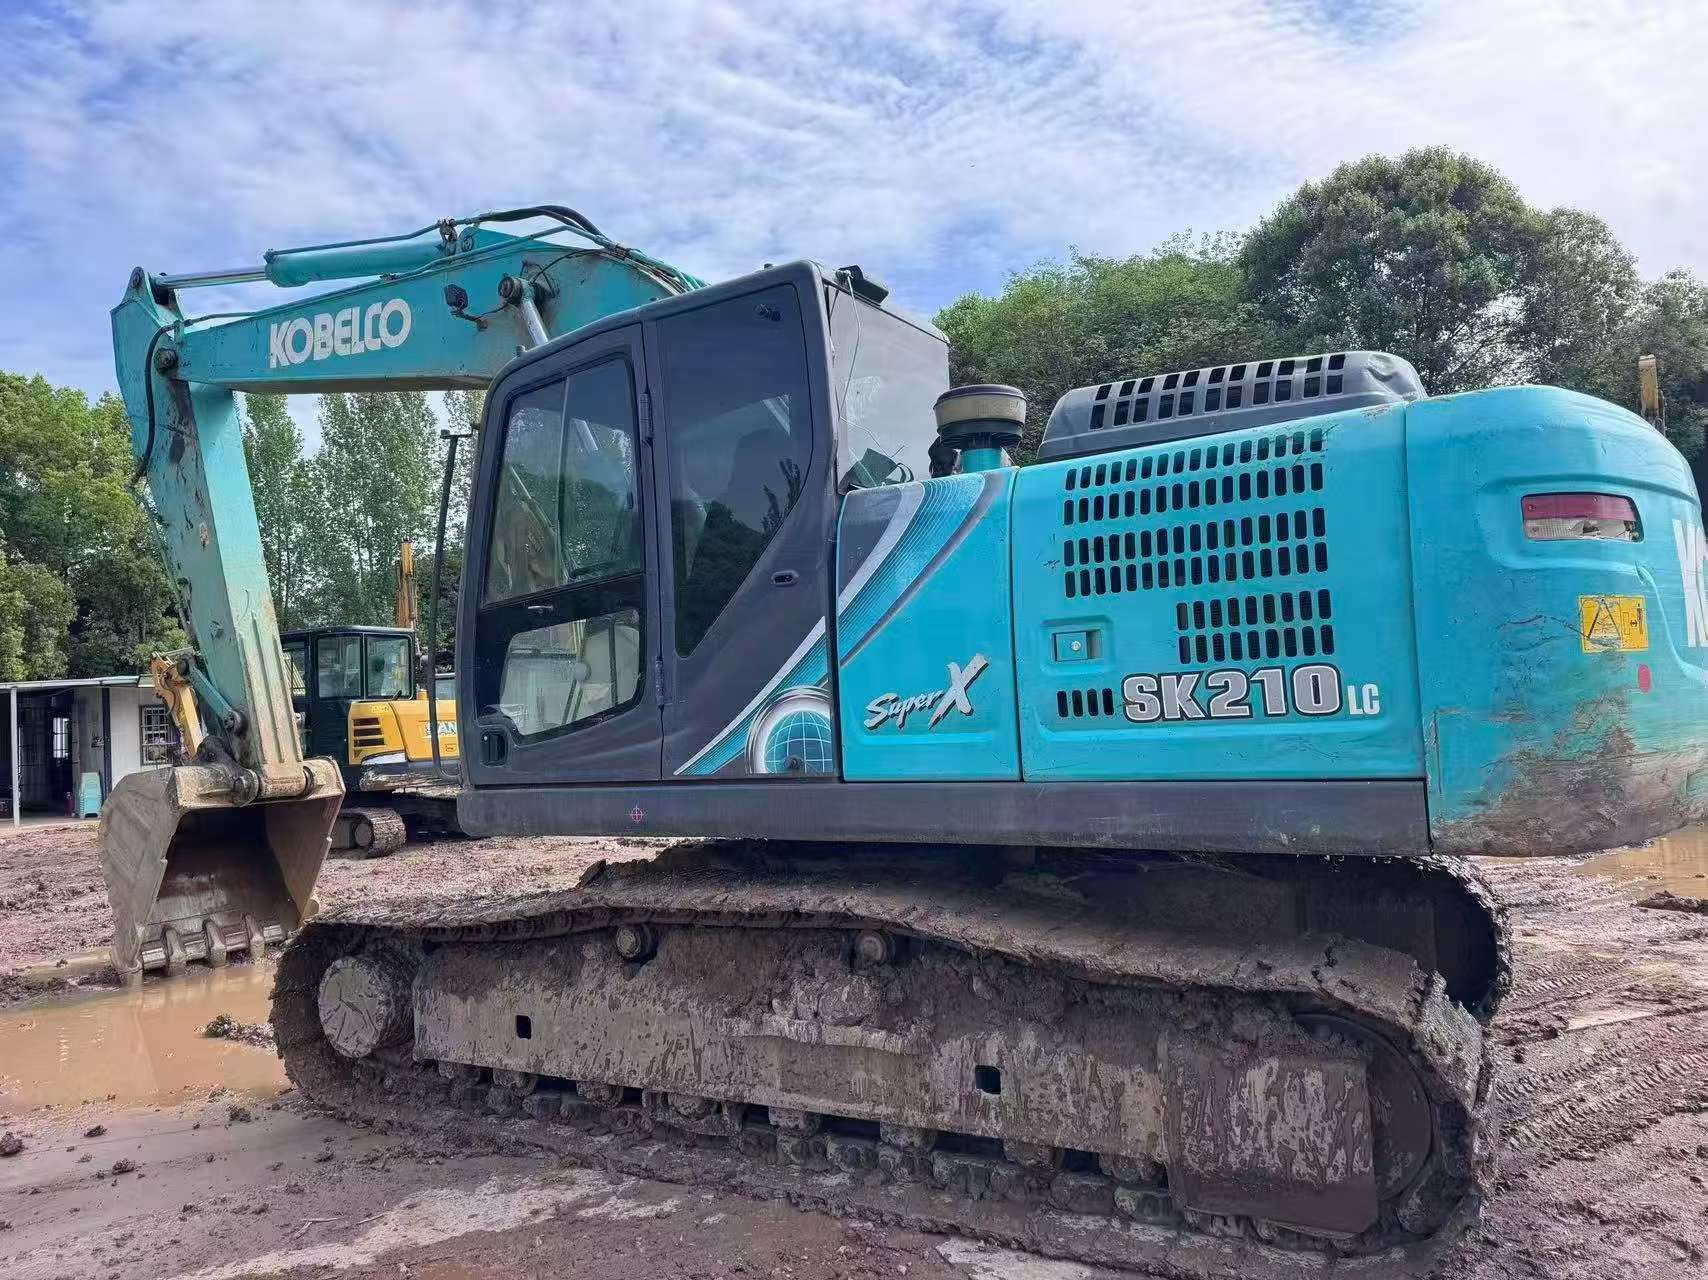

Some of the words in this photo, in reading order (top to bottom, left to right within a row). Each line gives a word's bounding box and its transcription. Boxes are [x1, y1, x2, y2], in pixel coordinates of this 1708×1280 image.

[269, 298, 412, 369] KOBELCO
[863, 692, 945, 730] Super
[928, 653, 989, 730] X
[1121, 662, 1342, 724] SK210
[1347, 683, 1381, 715] LC
